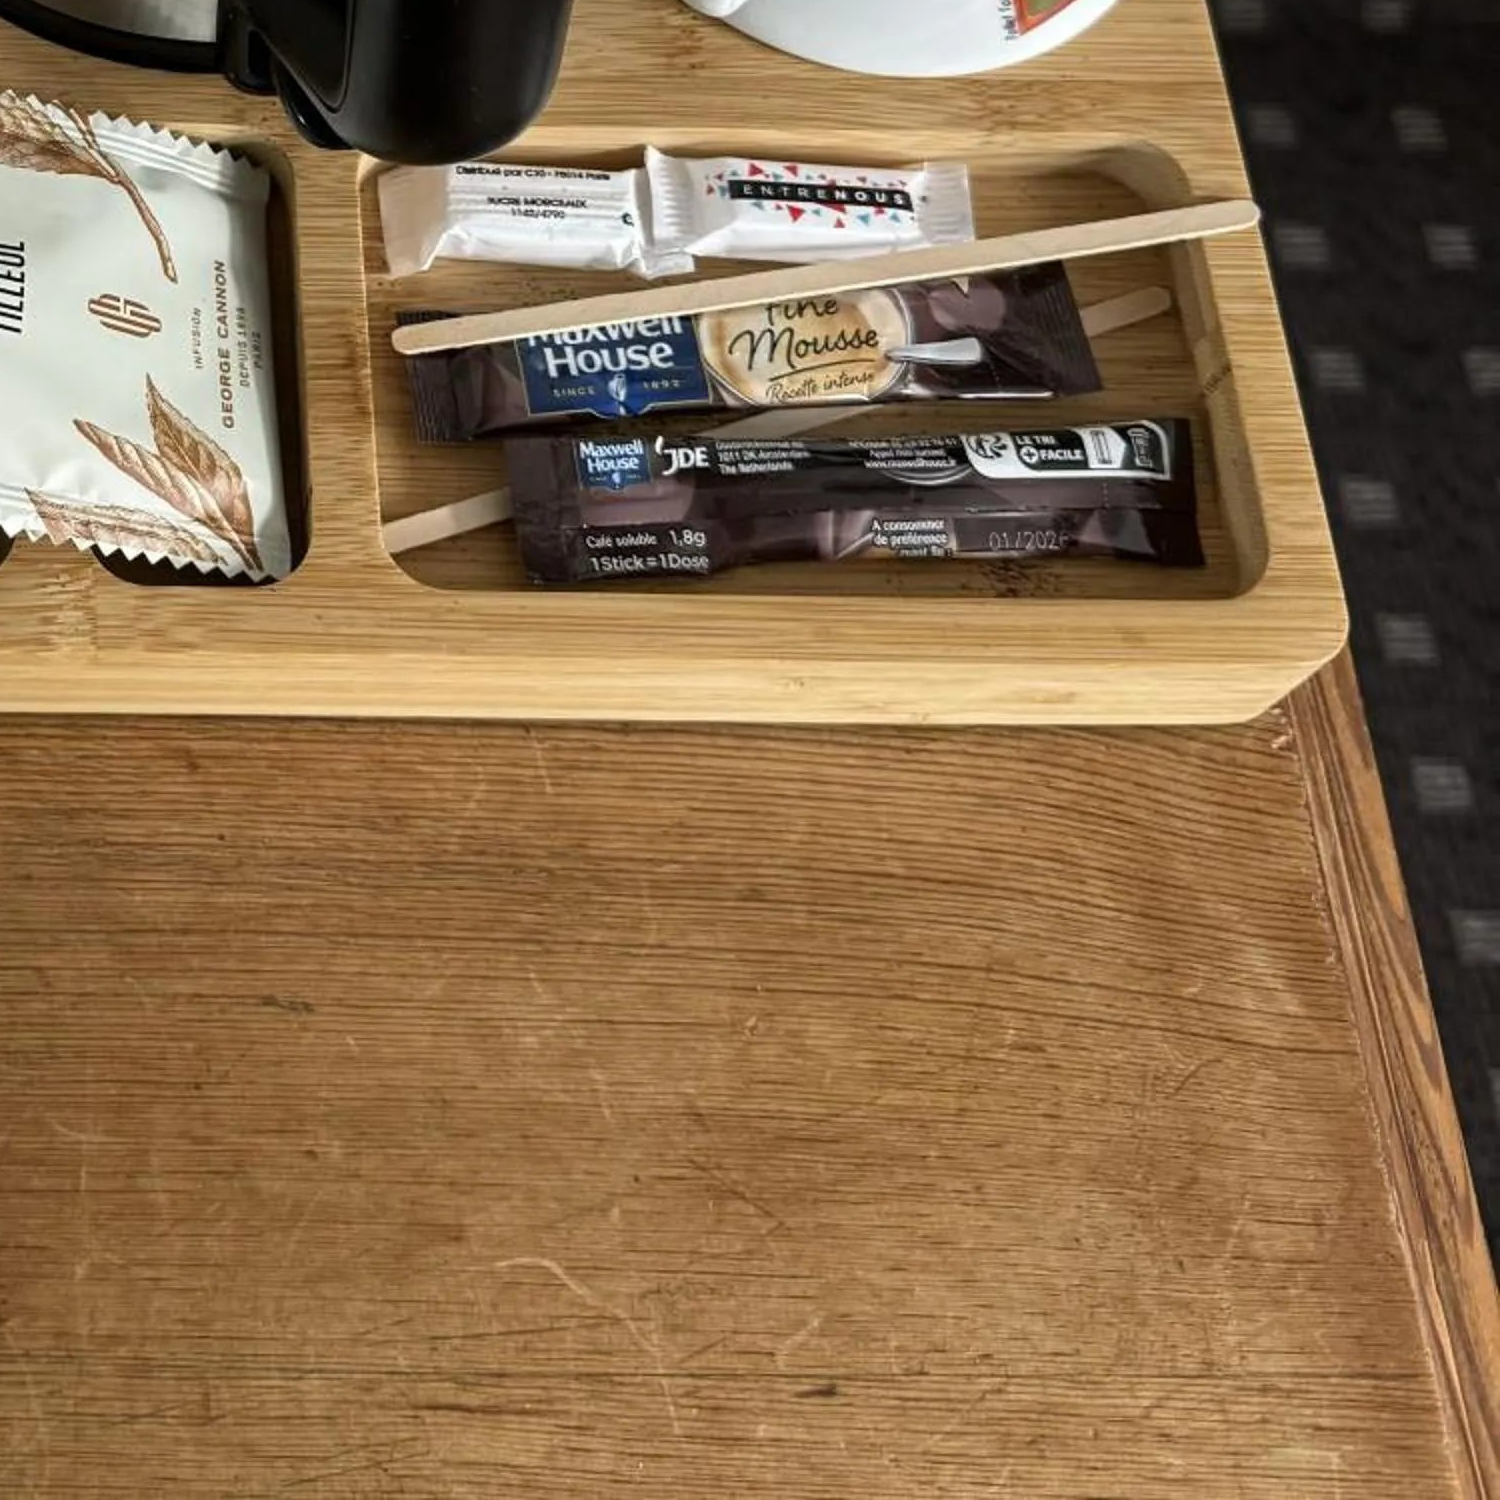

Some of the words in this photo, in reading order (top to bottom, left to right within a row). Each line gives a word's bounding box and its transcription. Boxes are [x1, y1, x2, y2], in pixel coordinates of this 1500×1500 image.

[214, 260, 229, 339] CANNON
[192, 307, 204, 369] INFUSION
[728, 327, 880, 371] Mousse
[543, 341, 675, 378] House
[218, 347, 235, 429] GEORGE
[553, 386, 596, 398] SINCE
[579, 438, 644, 458] Maxwell
[1041, 449, 1084, 461] FACILE
[587, 455, 640, 472] House
[616, 533, 657, 547] soluble
[669, 529, 706, 547] 1,8g
